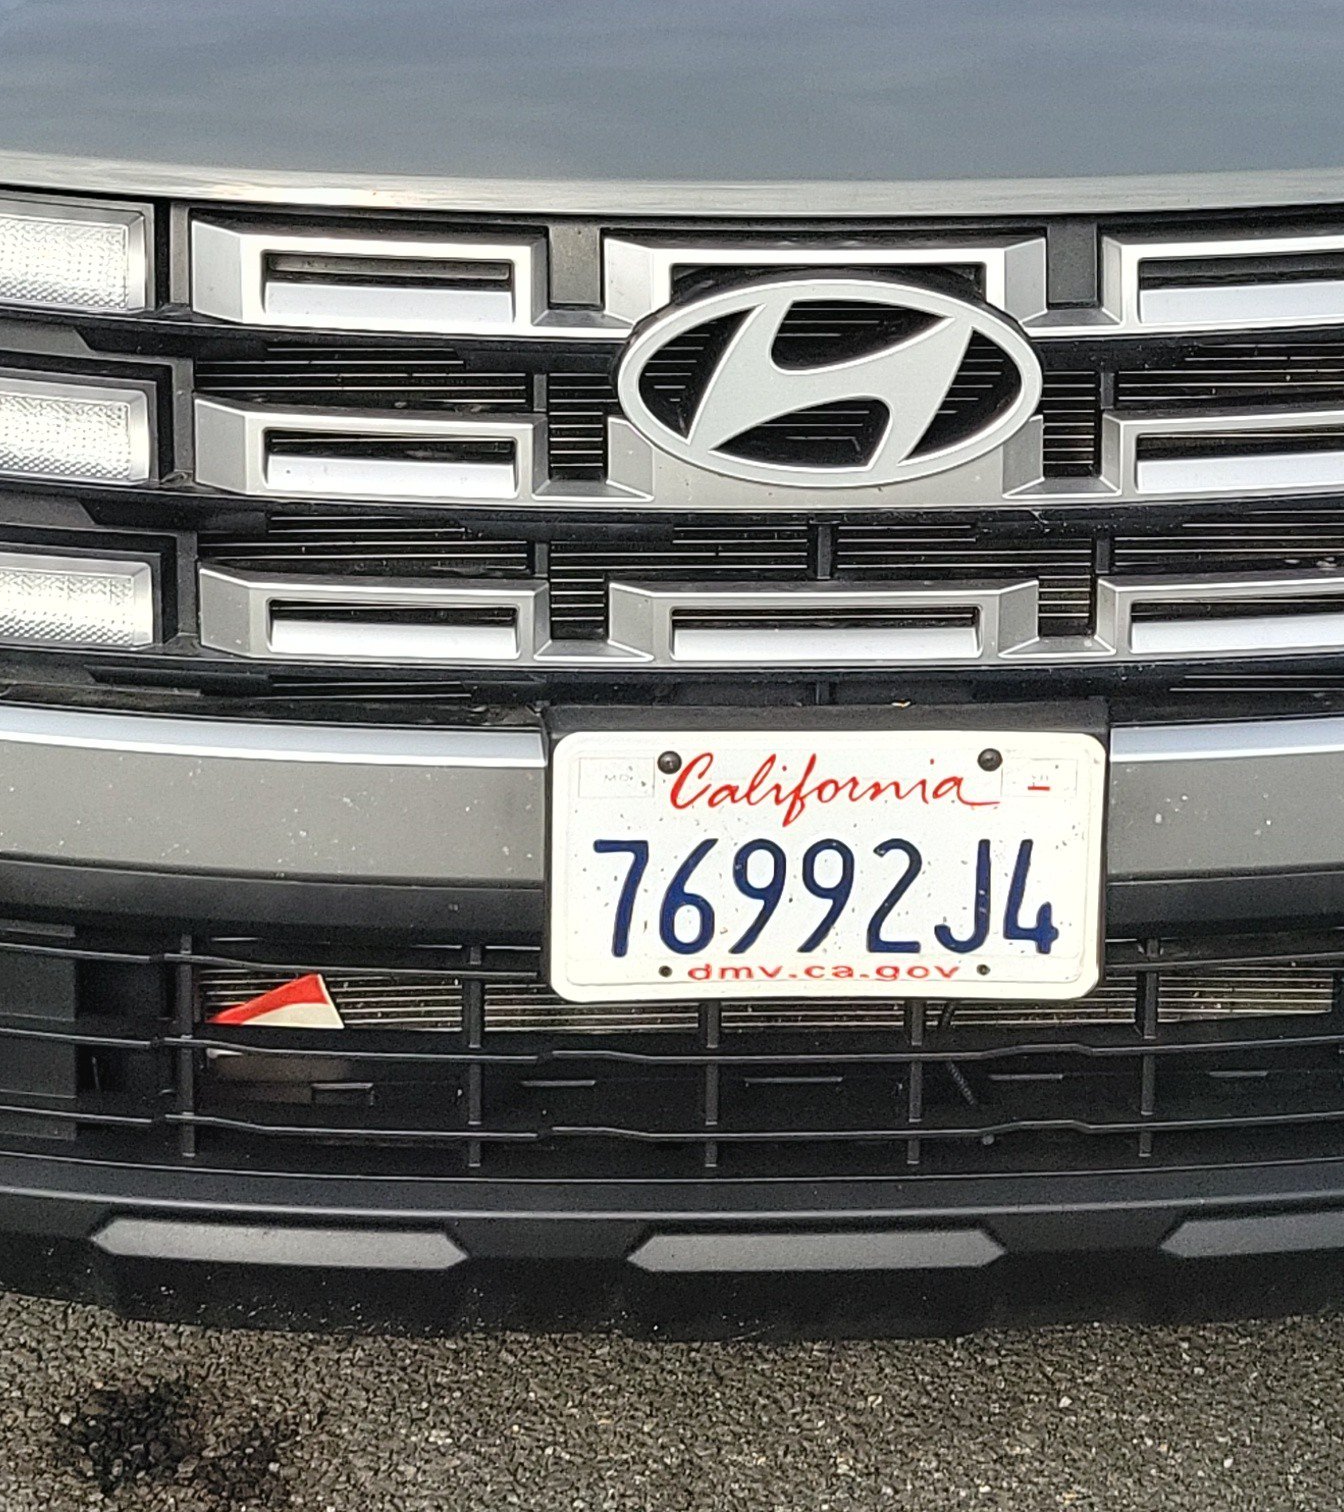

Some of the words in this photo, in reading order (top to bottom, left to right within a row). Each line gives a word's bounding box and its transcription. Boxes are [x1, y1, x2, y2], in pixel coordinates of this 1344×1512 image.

[670, 751, 1001, 827] California
[592, 837, 1060, 958] 76992J4
[687, 963, 961, 982] dmv.ca.gov
